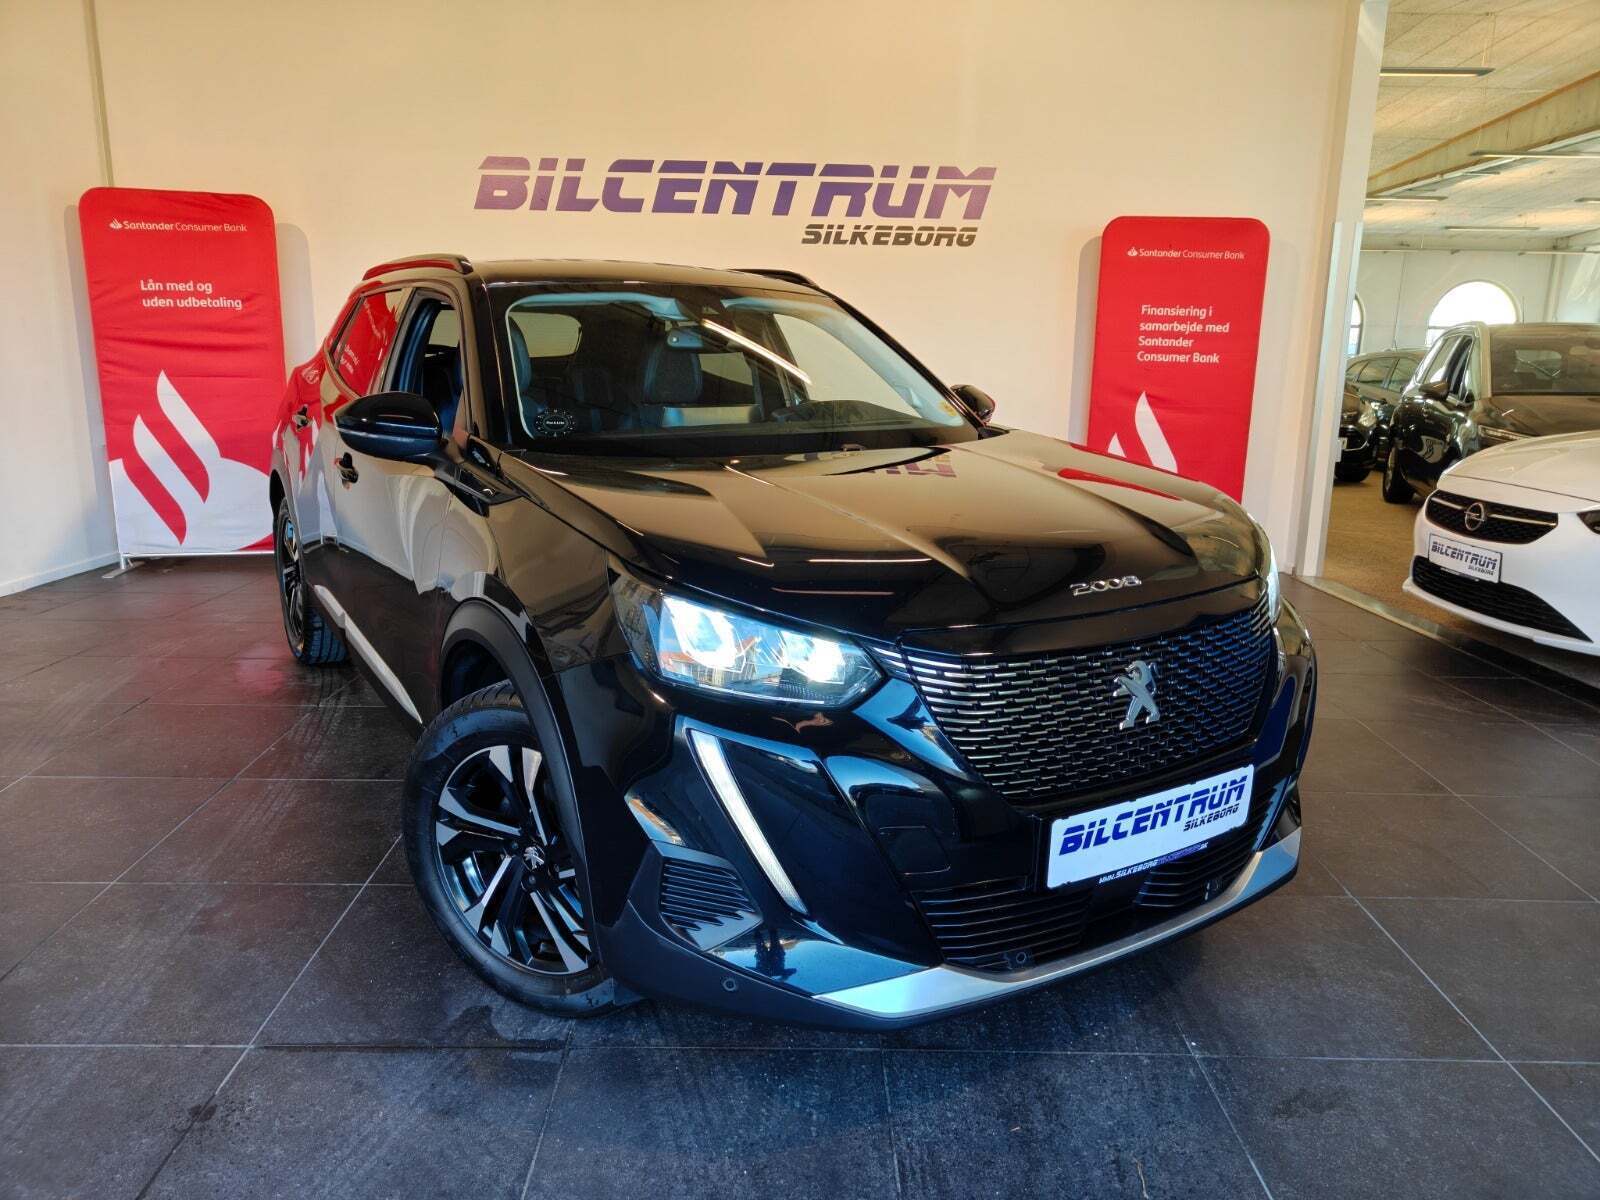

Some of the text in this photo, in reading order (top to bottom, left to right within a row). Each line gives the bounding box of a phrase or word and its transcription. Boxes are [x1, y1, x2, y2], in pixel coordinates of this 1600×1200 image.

[473, 155, 997, 220] BILCENTRUM
[123, 220, 247, 233] Santander Consumer Bank
[801, 223, 979, 247] SILKEBORG
[1139, 248, 1245, 260] Santander Consumer Bank
[140, 279, 213, 295] Lån med og
[143, 297, 242, 310] uden udbetaling
[1141, 304, 1207, 319] Finansiering
[1139, 321, 1230, 334] samarbejde med
[1138, 335, 1194, 347] Santander
[1136, 350, 1220, 363] Consumer Bank
[1431, 541, 1498, 570] BILCENTRUM
[1069, 575, 1142, 596] 2008
[1059, 775, 1248, 856] BILCENTRUM
[1183, 803, 1240, 832] SILKEBORG
